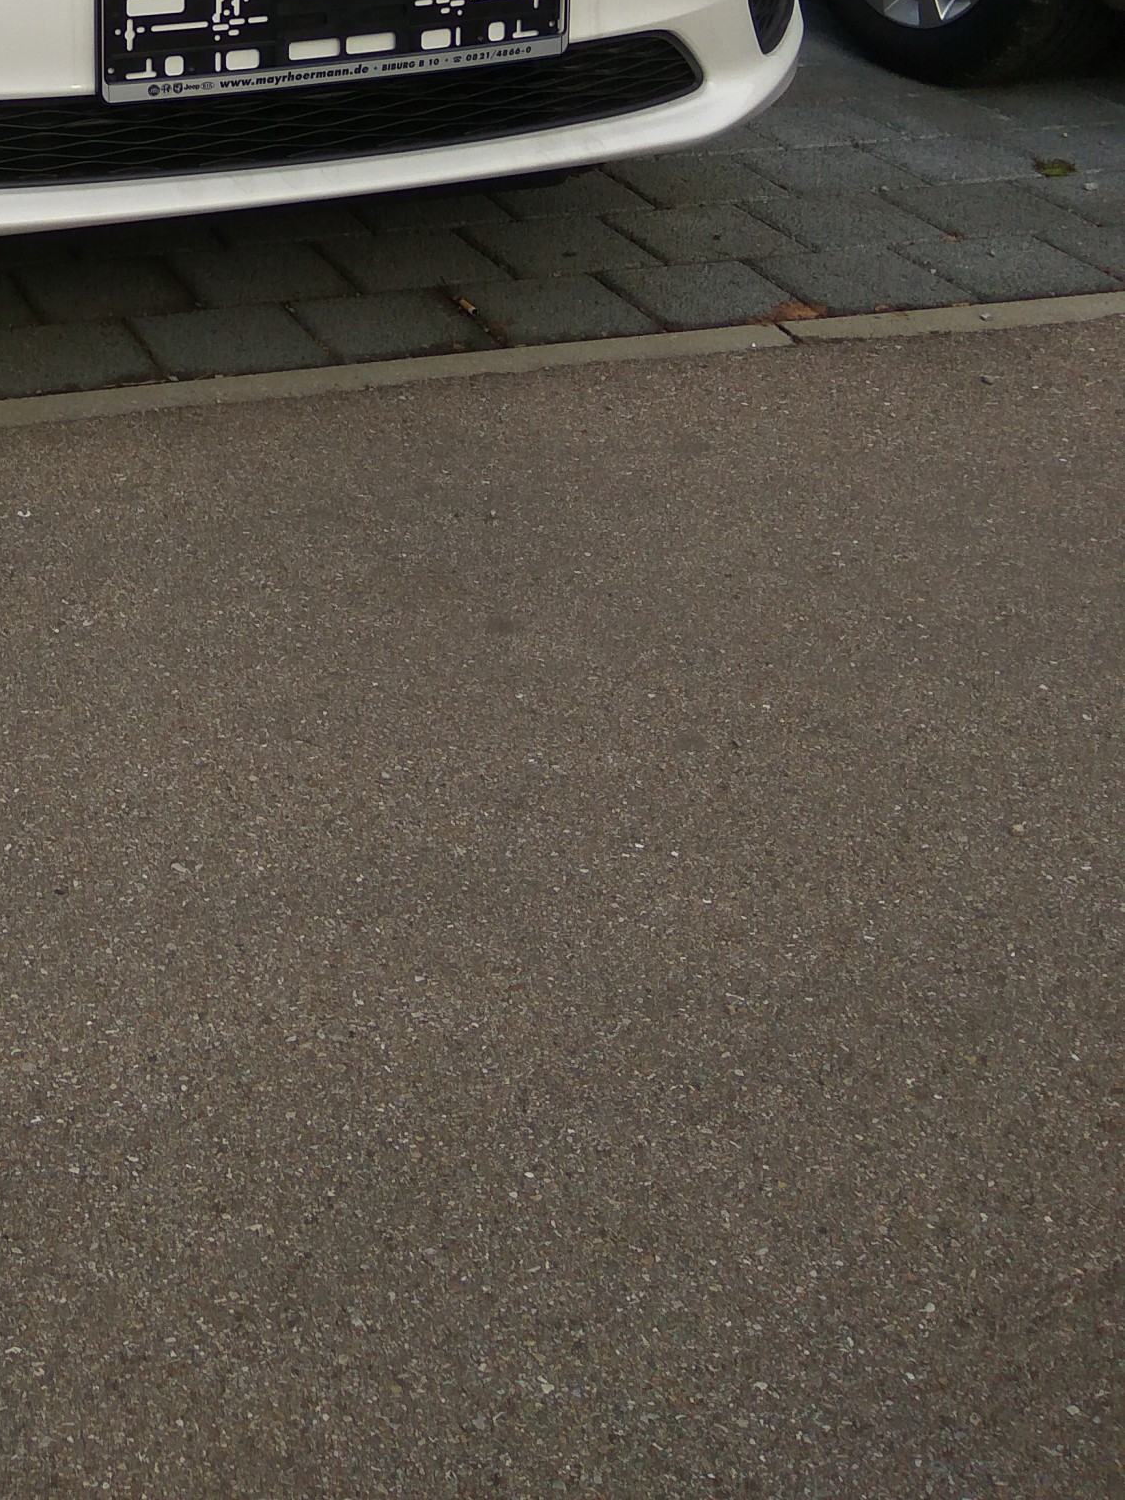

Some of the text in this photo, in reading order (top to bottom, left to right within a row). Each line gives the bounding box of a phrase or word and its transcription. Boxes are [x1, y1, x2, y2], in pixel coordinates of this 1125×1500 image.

[219, 64, 369, 89] www.mayrhoermann.de
[381, 60, 416, 71] BIBURG
[428, 58, 440, 66] 10
[465, 46, 532, 62] 0821/4866-0
